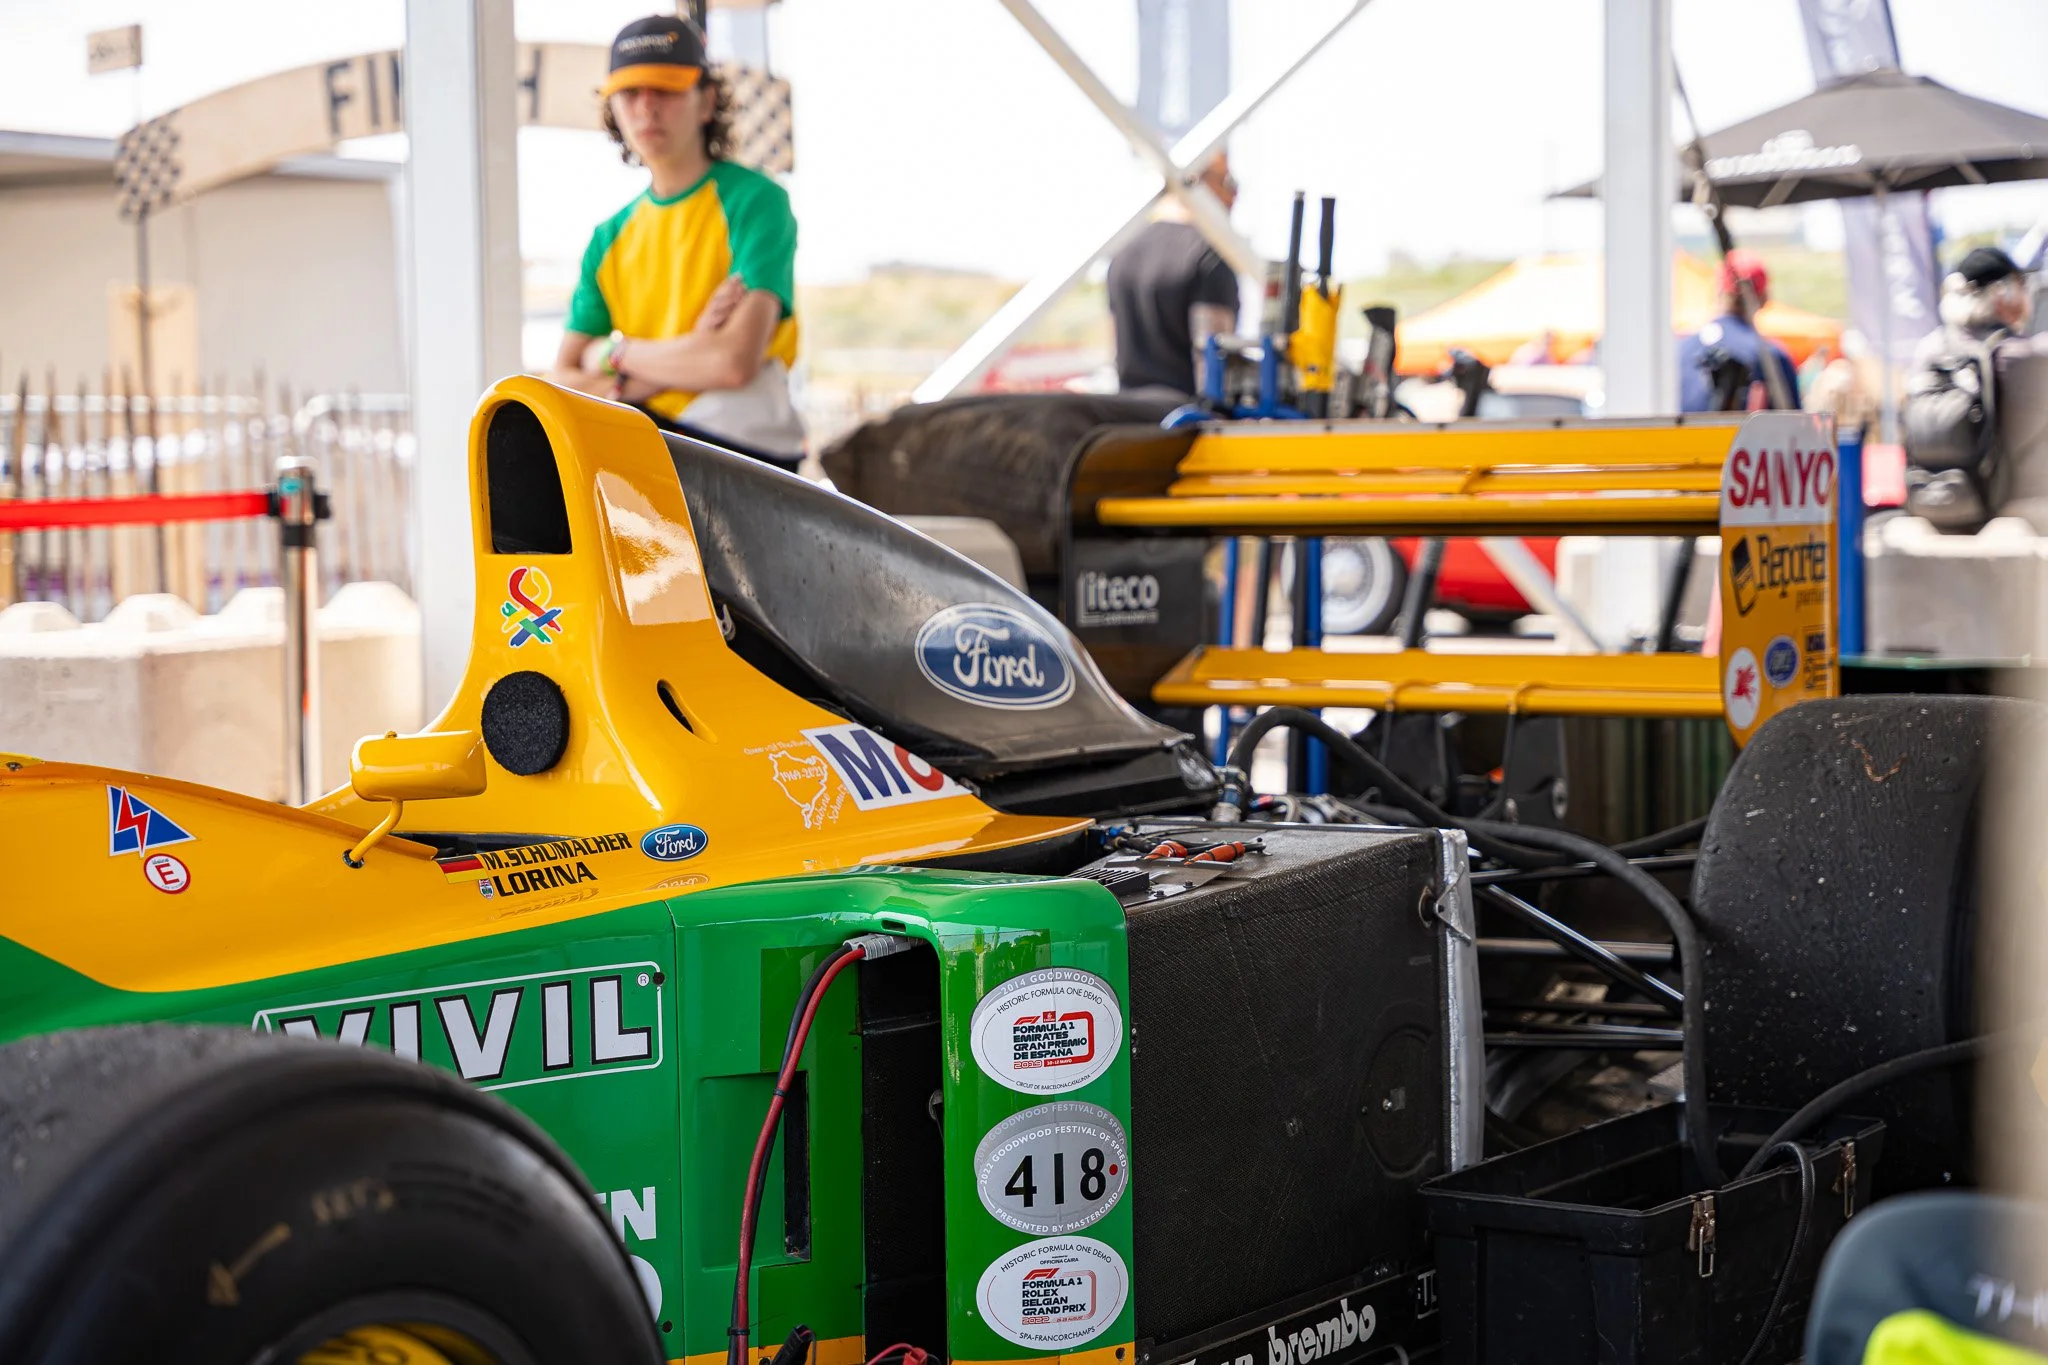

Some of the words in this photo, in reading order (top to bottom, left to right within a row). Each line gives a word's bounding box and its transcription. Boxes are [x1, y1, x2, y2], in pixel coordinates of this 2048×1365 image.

[1728, 448, 1834, 508] SANYO
[953, 623, 1045, 687] Ford
[482, 832, 633, 871] M.SCHUMACHER
[655, 829, 697, 854] Ford
[155, 863, 180, 885] E
[492, 861, 599, 897] LORINA
[1000, 979, 1026, 995] 2014
[1029, 971, 1095, 985] GOODWOOD
[997, 993, 1030, 1014] HISTORIC
[1030, 987, 1065, 998] FORMULA
[1066, 987, 1082, 996] ONE
[1083, 990, 1103, 1004] DEMO
[1013, 1022, 1067, 1034] FORMULA
[1068, 1021, 1075, 1029] 1
[1013, 1031, 1069, 1043] EMIRATES
[1013, 1042, 1046, 1051] GRAN
[1047, 1037, 1088, 1049] PREMIO
[1013, 1052, 1029, 1060] DE
[1013, 1060, 1043, 1069] 2019
[1015, 1081, 1034, 1089] CIRCUIT
[989, 1106, 1048, 1140] GOODWOOD
[1052, 1103, 1094, 1115] FESTIVAL
[1097, 1110, 1108, 1119] OF
[980, 1162, 994, 1185] 2022
[992, 1128, 1051, 1162] GOODWOOD
[1055, 1125, 1097, 1137] FESTIVAL
[1099, 1132, 1111, 1142] OF
[1110, 1140, 1127, 1168] SPEED
[1004, 1147, 1106, 1208] 418
[995, 1208, 1049, 1233] PRESENTED
[1066, 1192, 1118, 1230] MASTERCARD
[1000, 1250, 1037, 1273] HISTORIC
[1038, 1244, 1074, 1255] FORMULA
[1075, 1244, 1091, 1254] ONE
[1092, 1249, 1112, 1263] DEMO
[1022, 1278, 1075, 1289] FORMULA
[1077, 1277, 1083, 1285] 1
[1022, 1288, 1058, 1298] ROLEX
[1022, 1296, 1068, 1307] BELGIAN
[1022, 1306, 1061, 1315] GRAND
[1062, 1303, 1086, 1313] PRIX
[1022, 1316, 1050, 1325] 2022
[1268, 1298, 1376, 1365] brembo
[1019, 1326, 1096, 1341] SPA-FRANCORCHAMPS
